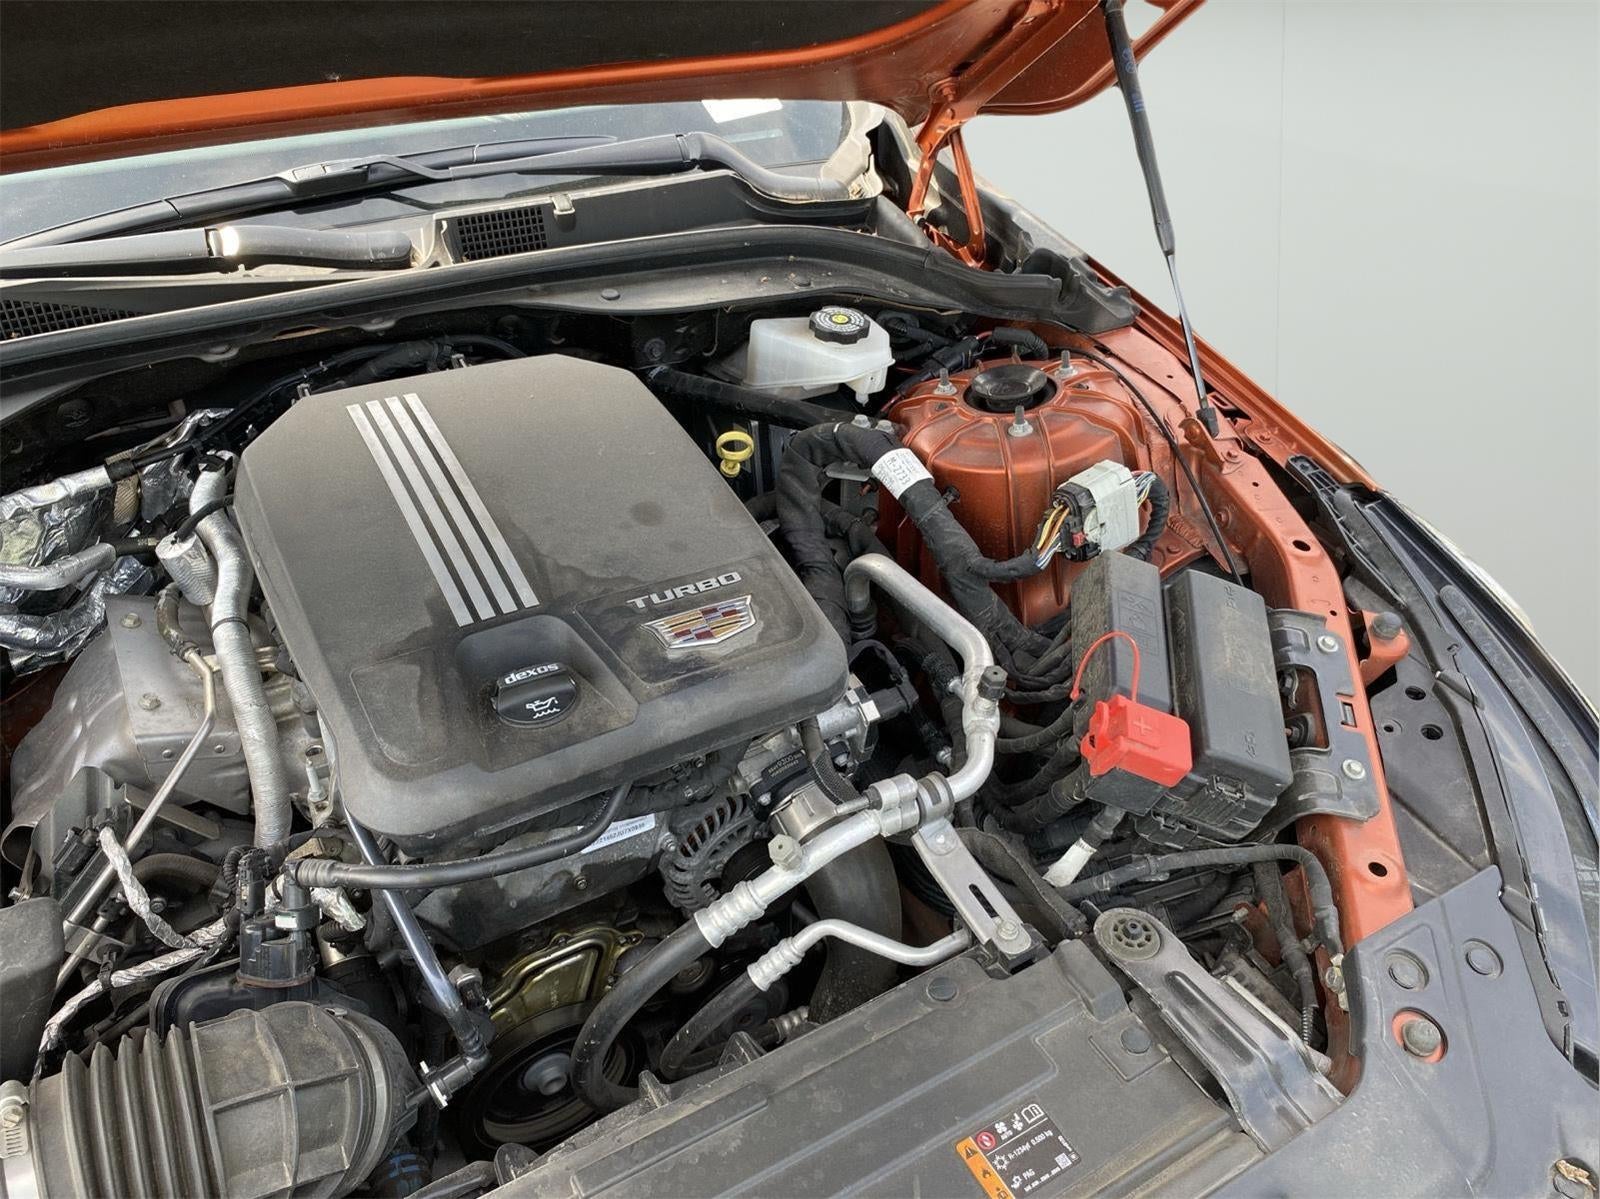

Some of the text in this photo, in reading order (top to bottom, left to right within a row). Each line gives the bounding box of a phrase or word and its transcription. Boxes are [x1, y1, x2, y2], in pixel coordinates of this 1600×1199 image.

[626, 571, 742, 609] TURBO
[504, 663, 559, 684] dexos
[1022, 1168, 1035, 1180] PAG
